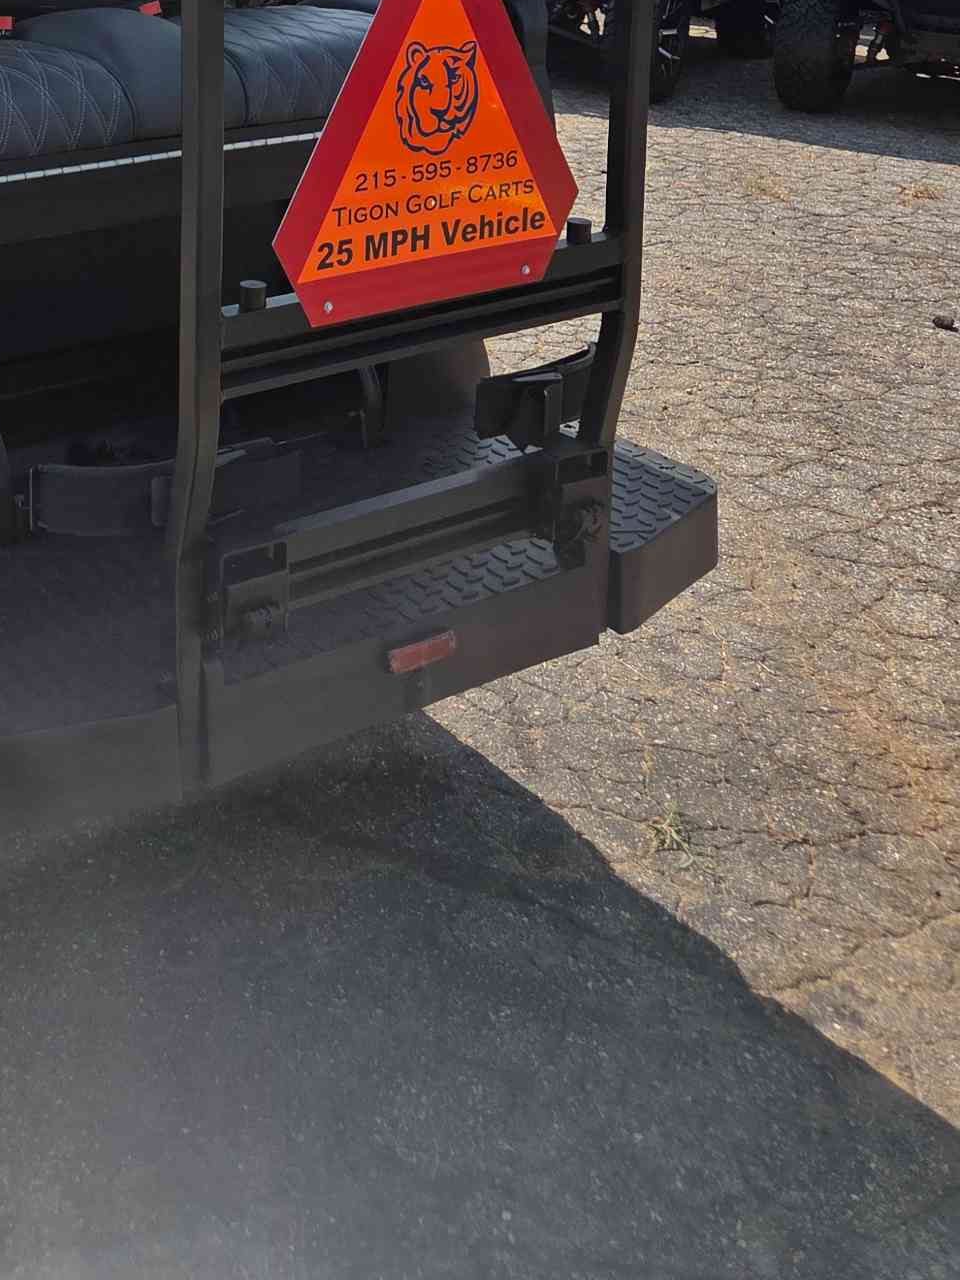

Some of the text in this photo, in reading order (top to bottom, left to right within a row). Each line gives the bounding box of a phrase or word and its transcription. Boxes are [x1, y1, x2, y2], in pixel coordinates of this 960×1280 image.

[332, 179, 535, 227] TIGON GOLF CARTS
[316, 207, 546, 270] 25 MPH Vehicle
